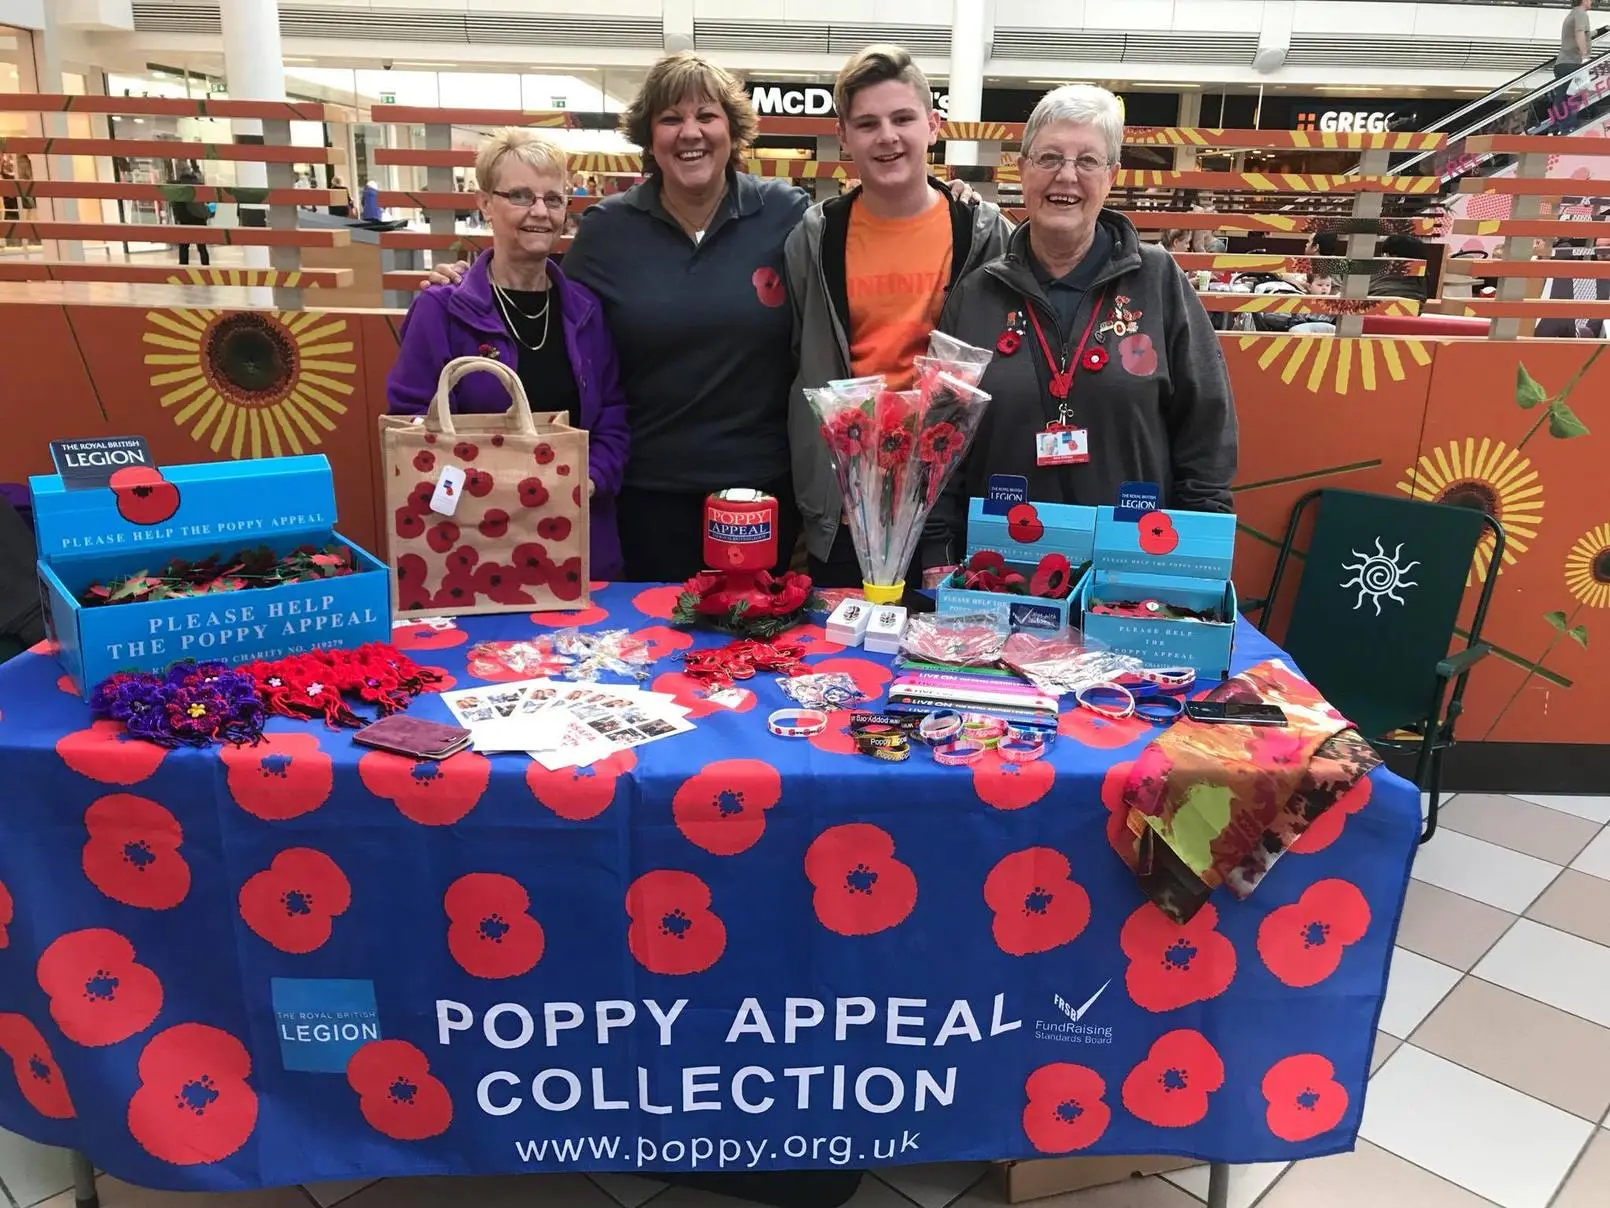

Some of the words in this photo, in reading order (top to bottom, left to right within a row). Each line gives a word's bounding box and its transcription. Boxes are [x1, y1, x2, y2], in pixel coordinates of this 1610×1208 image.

[848, 272, 938, 298] INFINIT
[79, 441, 107, 450] ROYAL
[108, 440, 140, 449] BRITISH
[65, 449, 145, 467] LEGION
[991, 492, 1023, 502] LEGION
[1121, 499, 1156, 510] LEGION
[713, 511, 767, 525] POPPY
[62, 532, 125, 549] PLEASE
[132, 527, 174, 542] HELP
[180, 524, 211, 537] THE
[217, 518, 264, 533] POPPY
[271, 513, 325, 527] APPEAL
[712, 523, 767, 535] APPEAL
[149, 605, 256, 634] PLEASE
[268, 595, 335, 618] HELP
[107, 638, 166, 661] THE
[181, 624, 268, 650] POPPY
[281, 608, 378, 637] APPEAL
[1119, 626, 1159, 634] PLEASE
[1165, 629, 1193, 637] HELP
[233, 648, 283, 664] CHARITY
[288, 644, 307, 657] NO.
[1153, 651, 1195, 659] APPEAL
[277, 1011, 296, 1020] THE
[299, 1011, 333, 1020] ROYAL
[336, 1010, 376, 1019] BRITISH
[1054, 993, 1077, 1023] FRSB
[435, 998, 689, 1050] POPPY
[725, 992, 1022, 1048] APPEAL
[1035, 1020, 1113, 1037] FundRaising
[281, 1023, 378, 1042] LEGION
[1035, 1031, 1082, 1043] Standards
[1084, 1035, 1112, 1044] Board
[476, 1064, 958, 1115] COLLECTION
[514, 1129, 921, 1168] www.poppy.org.uk
